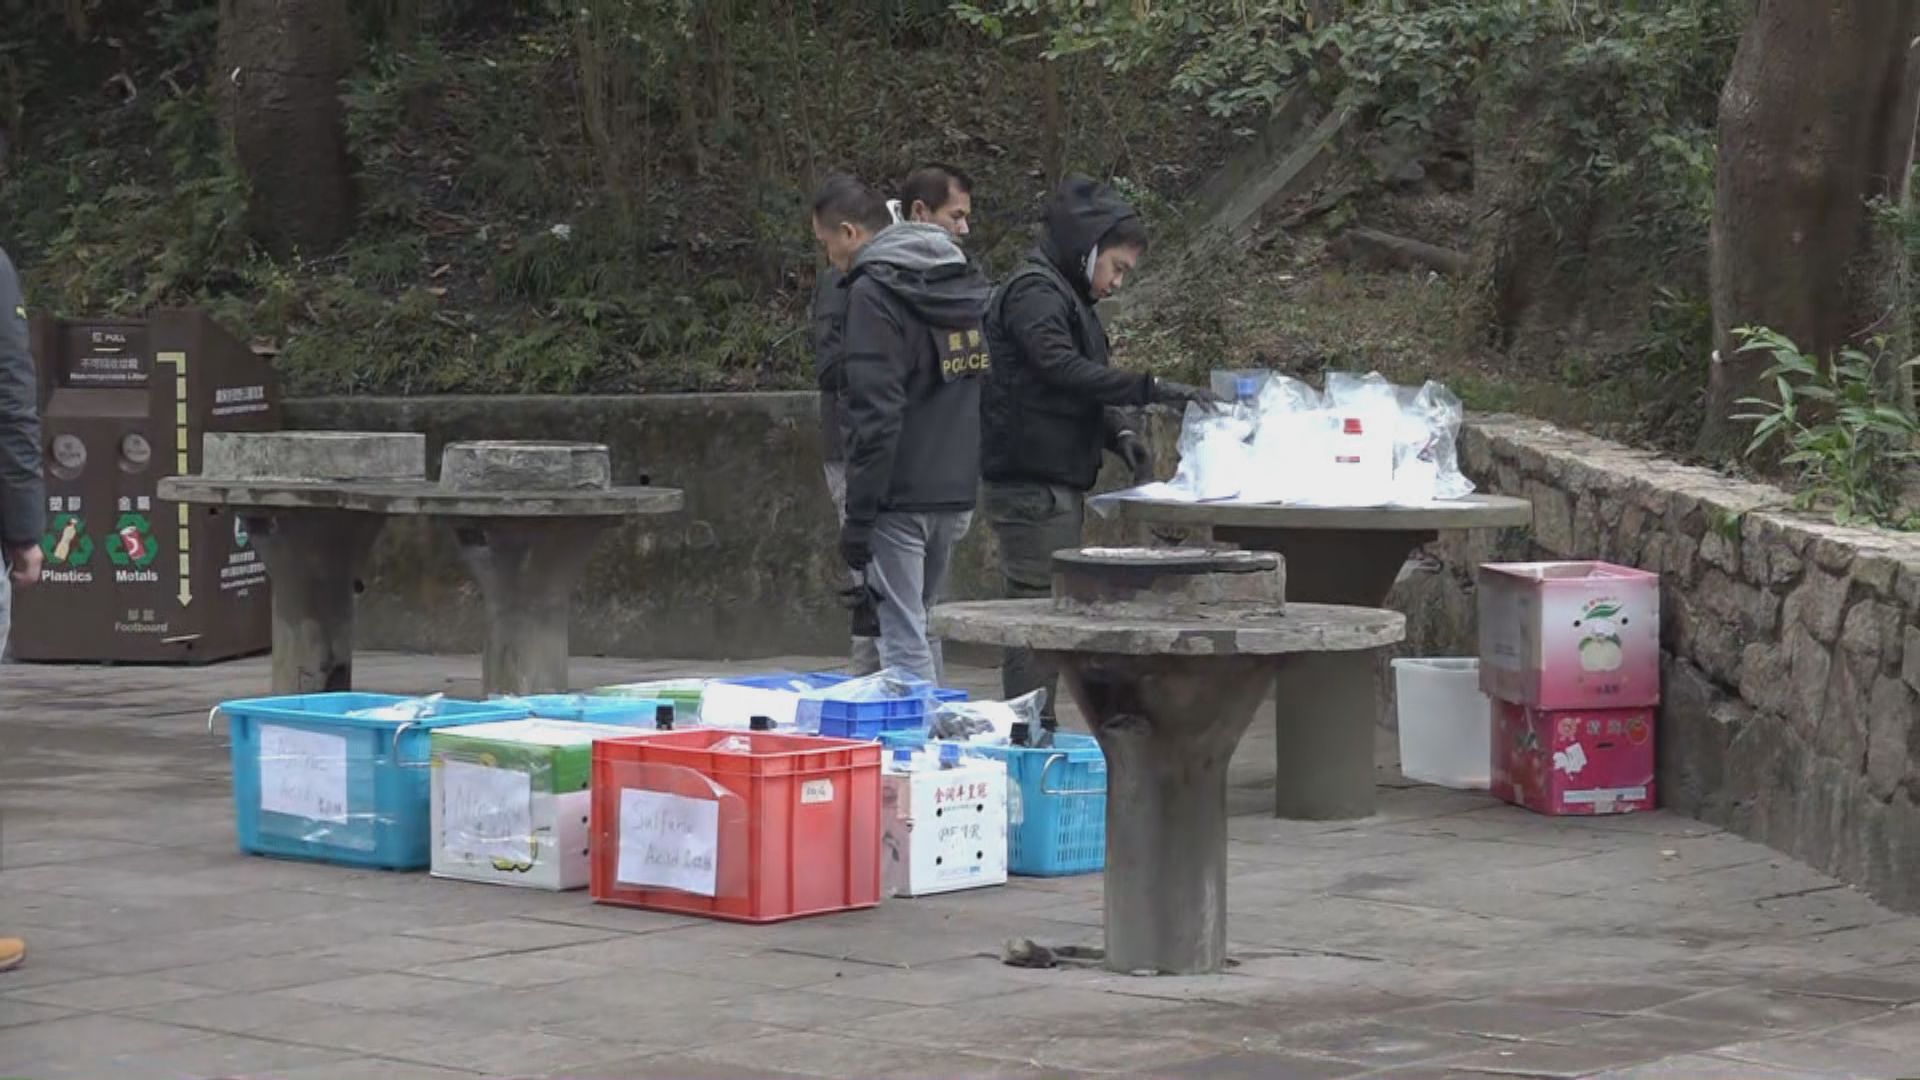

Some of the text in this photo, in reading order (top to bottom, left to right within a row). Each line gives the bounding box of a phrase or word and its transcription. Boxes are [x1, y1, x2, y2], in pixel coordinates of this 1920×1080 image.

[41, 569, 93, 582] Plastics
[116, 569, 158, 582] Metals
[114, 621, 169, 632] Footboard
